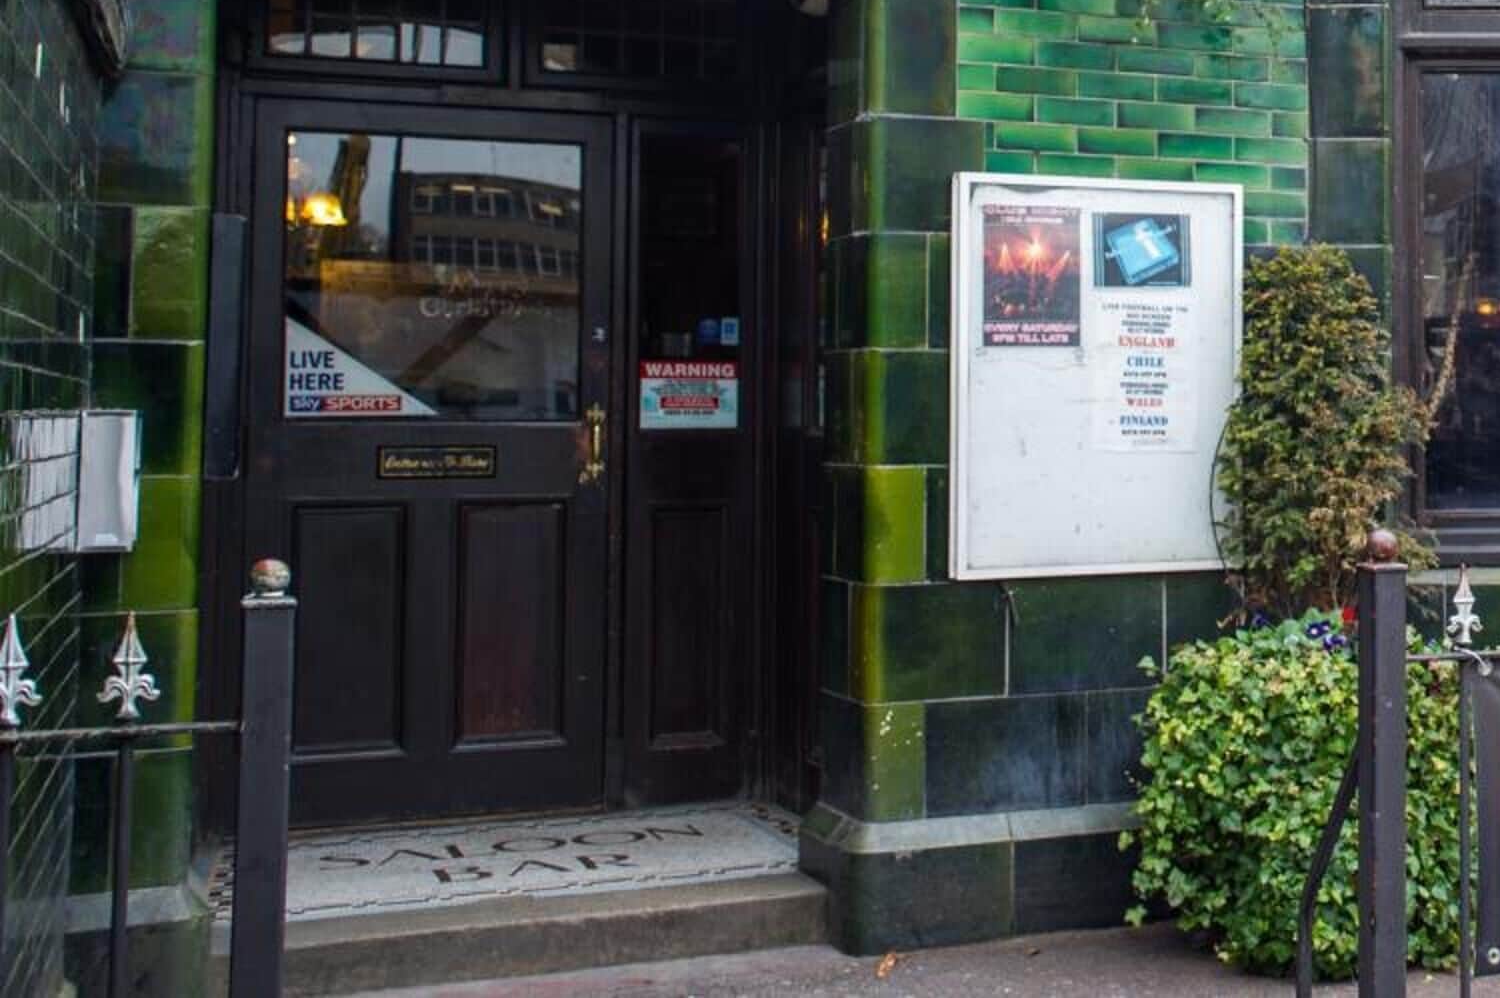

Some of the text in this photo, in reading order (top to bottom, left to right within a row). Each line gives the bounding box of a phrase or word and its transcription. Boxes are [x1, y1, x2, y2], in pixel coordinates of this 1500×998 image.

[289, 351, 335, 369] LIVE
[1127, 356, 1164, 368] CHILE
[645, 362, 736, 377] WARNING
[289, 373, 345, 391] HERE
[323, 396, 399, 411] SPORTS
[1119, 415, 1169, 427] FINLAND
[319, 823, 705, 872] SALOON
[433, 852, 640, 884] BAR
